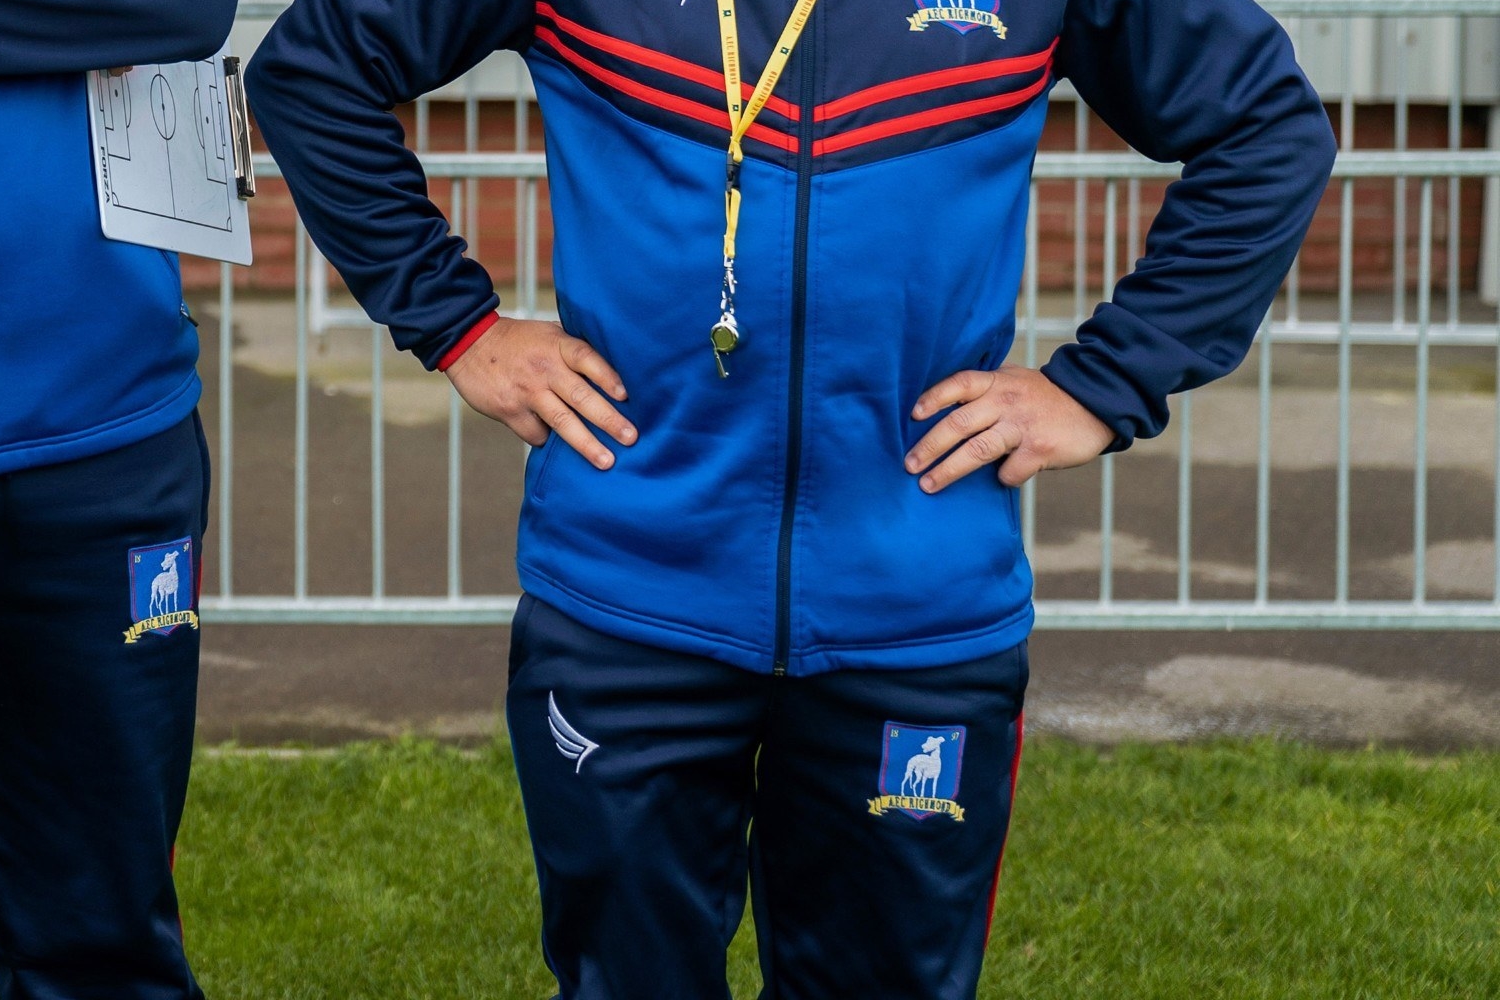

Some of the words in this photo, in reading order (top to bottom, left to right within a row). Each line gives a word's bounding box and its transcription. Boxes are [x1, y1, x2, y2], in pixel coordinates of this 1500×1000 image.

[947, 8, 992, 25] RICHMOND
[727, 50, 738, 85] RICHMOND
[758, 70, 778, 103] RICHMOND
[100, 146, 111, 203] FORZA
[909, 798, 951, 812] RICHMOND
